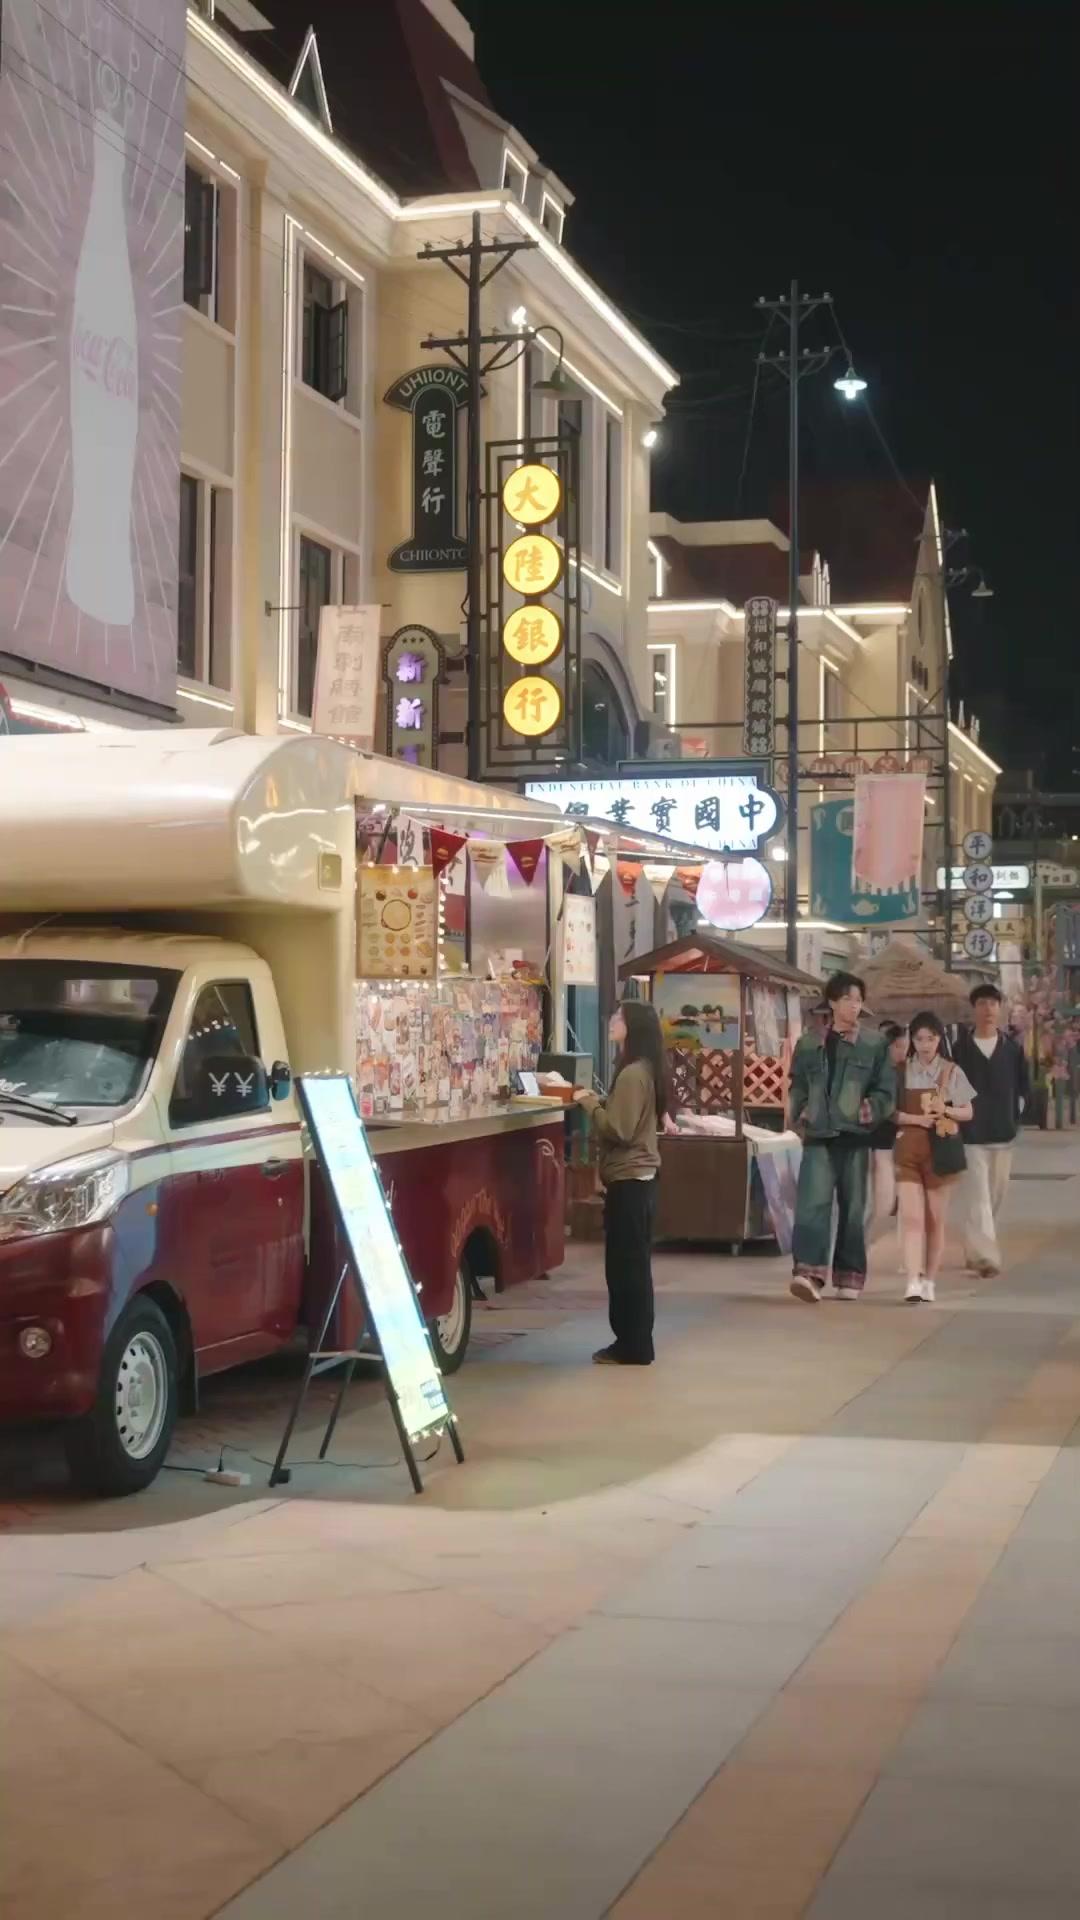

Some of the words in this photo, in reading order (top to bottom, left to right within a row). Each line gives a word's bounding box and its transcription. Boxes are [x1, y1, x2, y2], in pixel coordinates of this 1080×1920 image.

[421, 410, 446, 515] 電聲行
[513, 475, 549, 722] 大陸銀行
